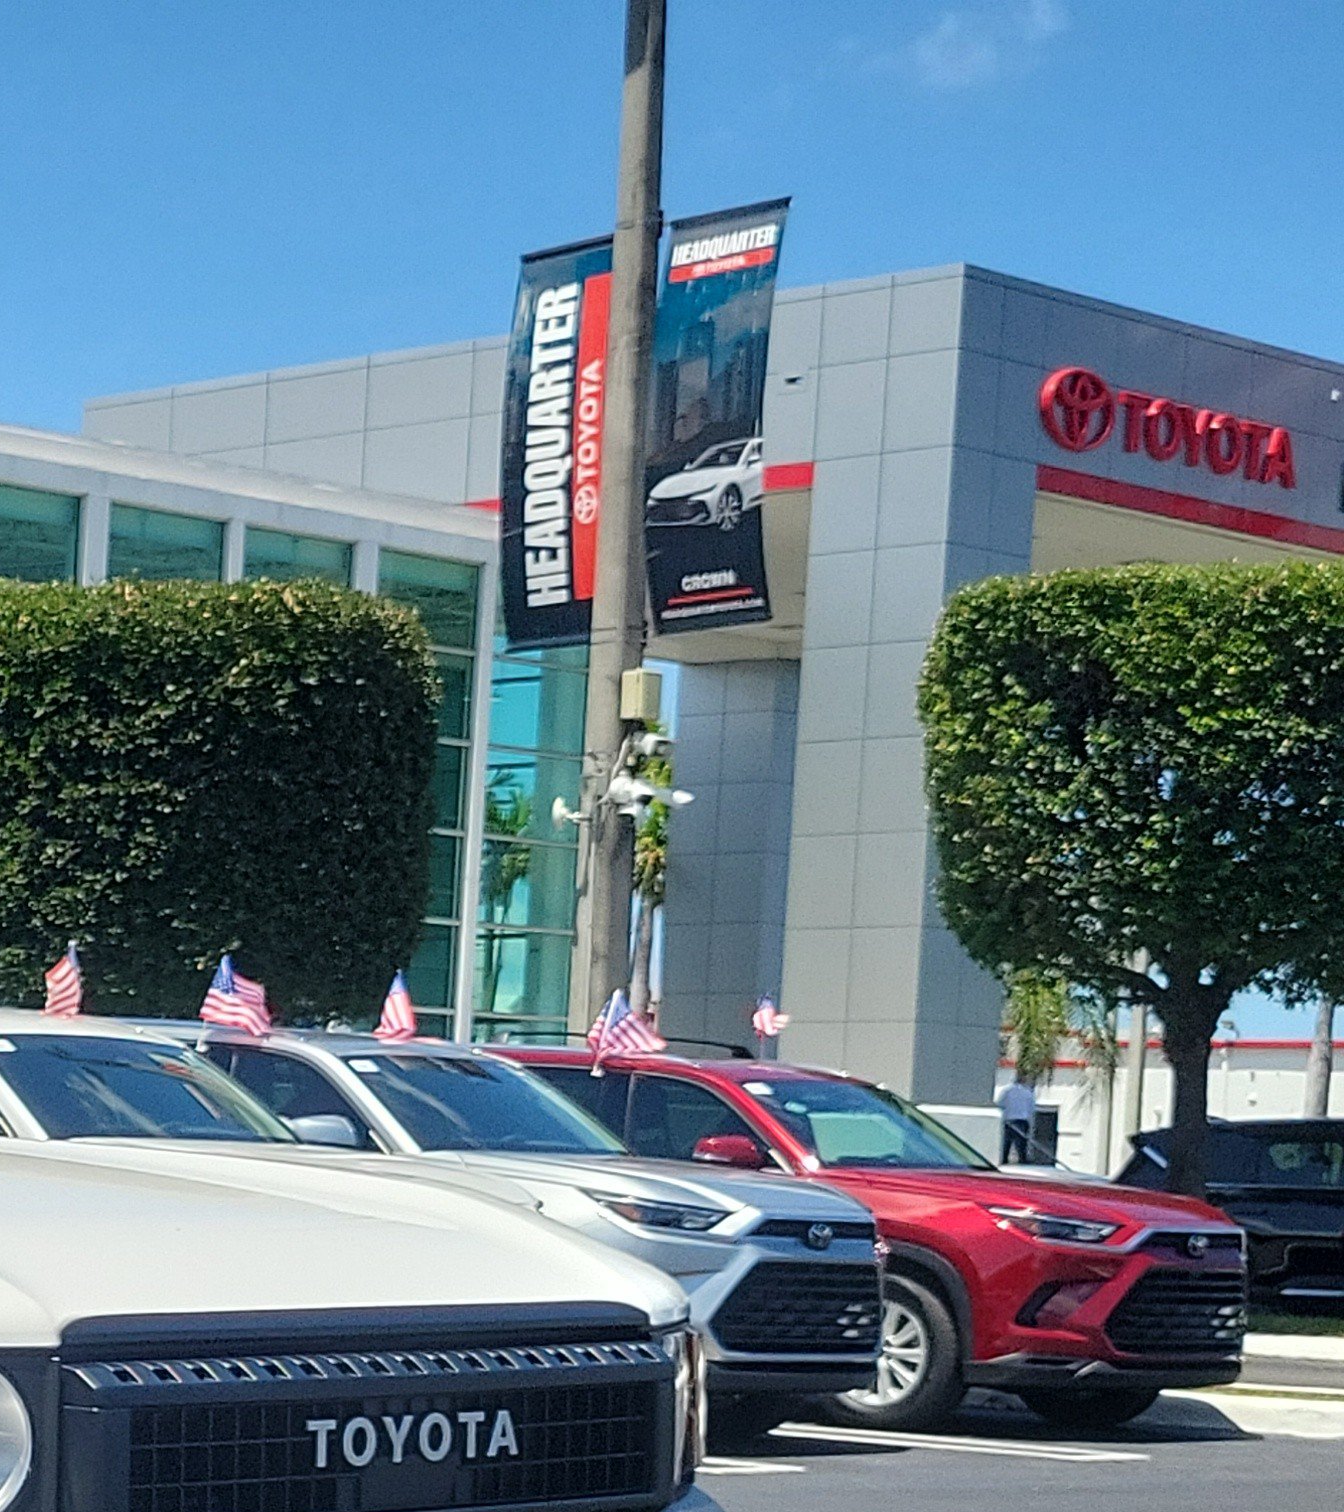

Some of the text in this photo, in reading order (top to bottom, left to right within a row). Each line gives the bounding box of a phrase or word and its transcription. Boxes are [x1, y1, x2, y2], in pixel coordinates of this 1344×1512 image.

[670, 222, 777, 267] HEADQUARTER
[523, 281, 580, 608] HEADQUARTER
[576, 357, 604, 484] TOYOTA
[1117, 389, 1296, 489] TOYOTA
[305, 1409, 519, 1468] TOYOTA
